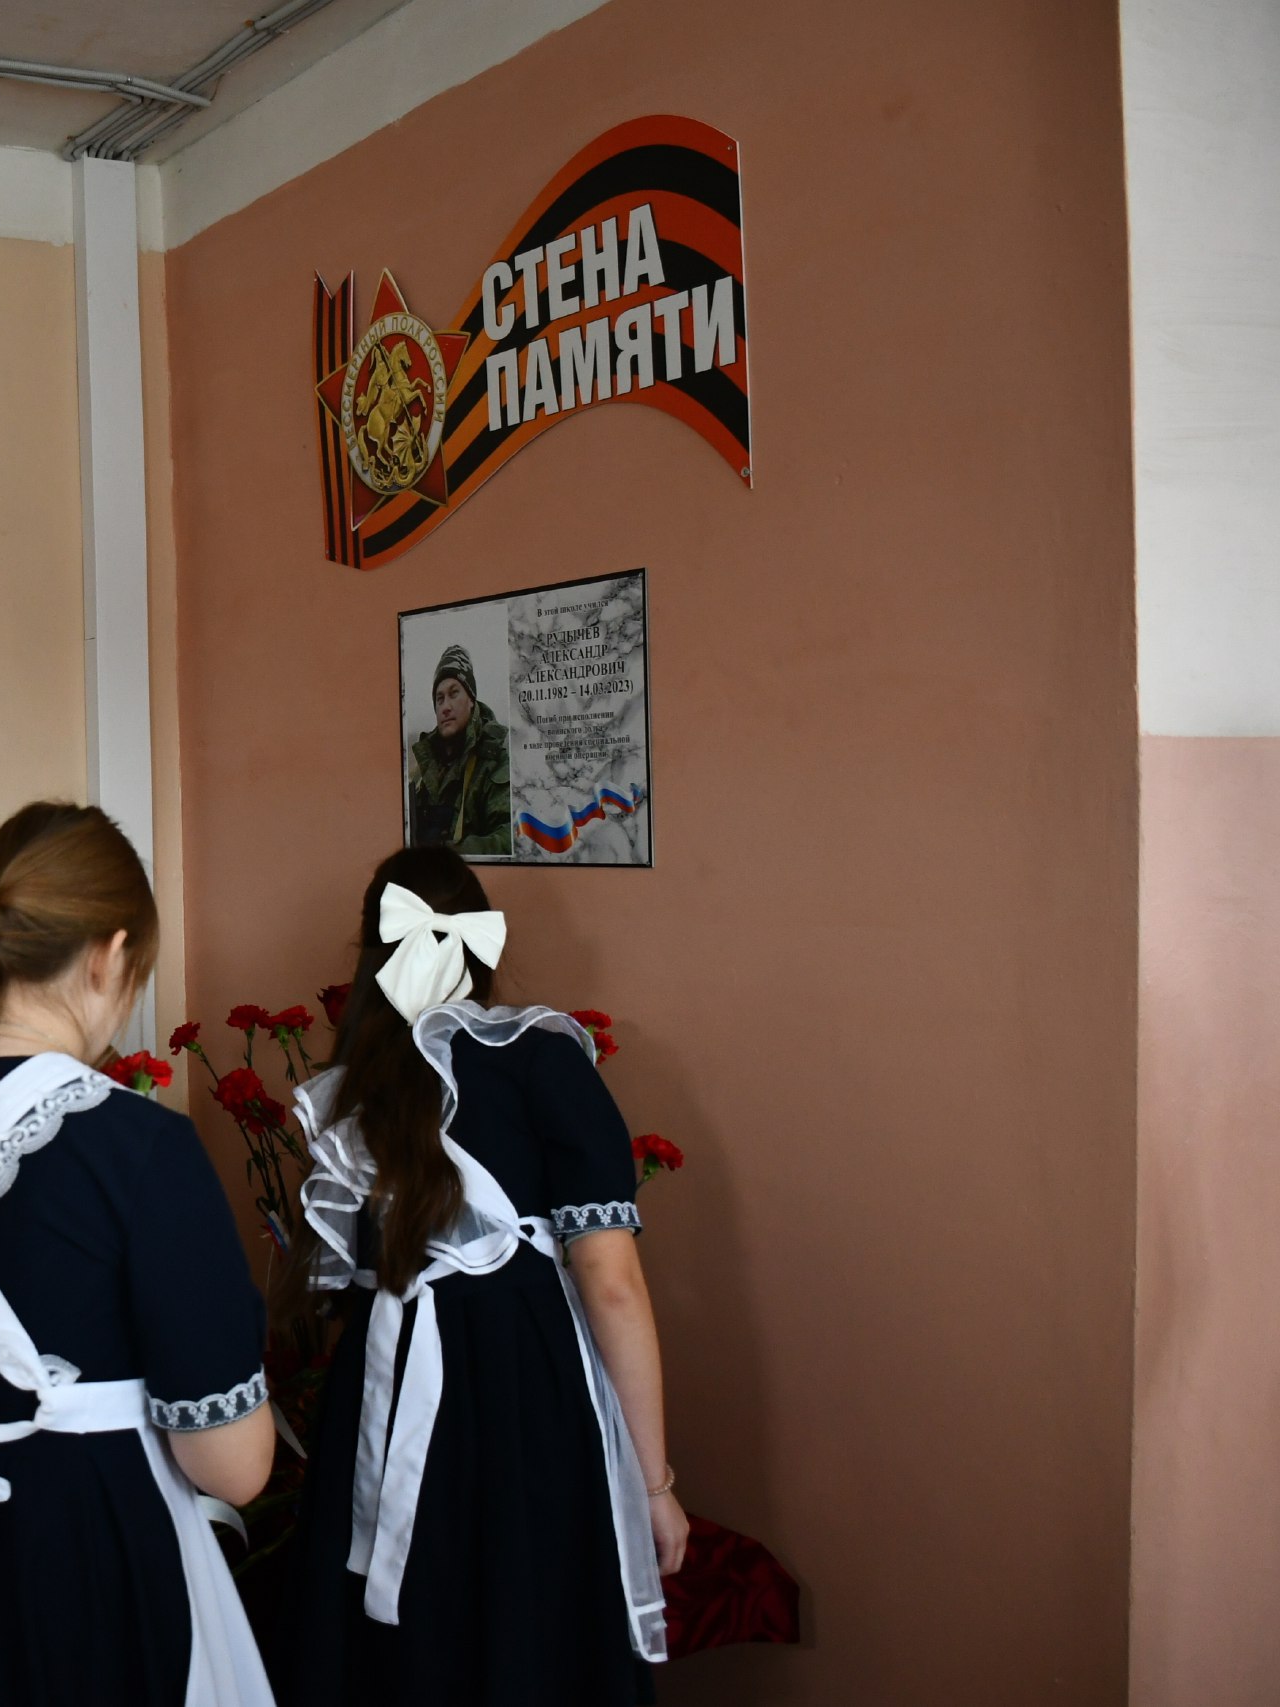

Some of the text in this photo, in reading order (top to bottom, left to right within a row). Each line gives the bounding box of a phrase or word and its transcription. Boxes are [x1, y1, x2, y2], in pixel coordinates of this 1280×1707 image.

[482, 203, 665, 341] СТЕНА
[486, 276, 736, 432] ПАМЯТИ
[391, 316, 426, 342] ПОЛК
[424, 337, 445, 423] РОССИИ
[537, 600, 609, 618] В этой школе учился
[540, 644, 608, 664] АЛЕКСАНДР
[525, 661, 625, 684] АЛЕКСАНДРОВИЧ
[518, 686, 568, 704] (20.11.1982
[579, 680, 634, 698] 14.03.2023)
